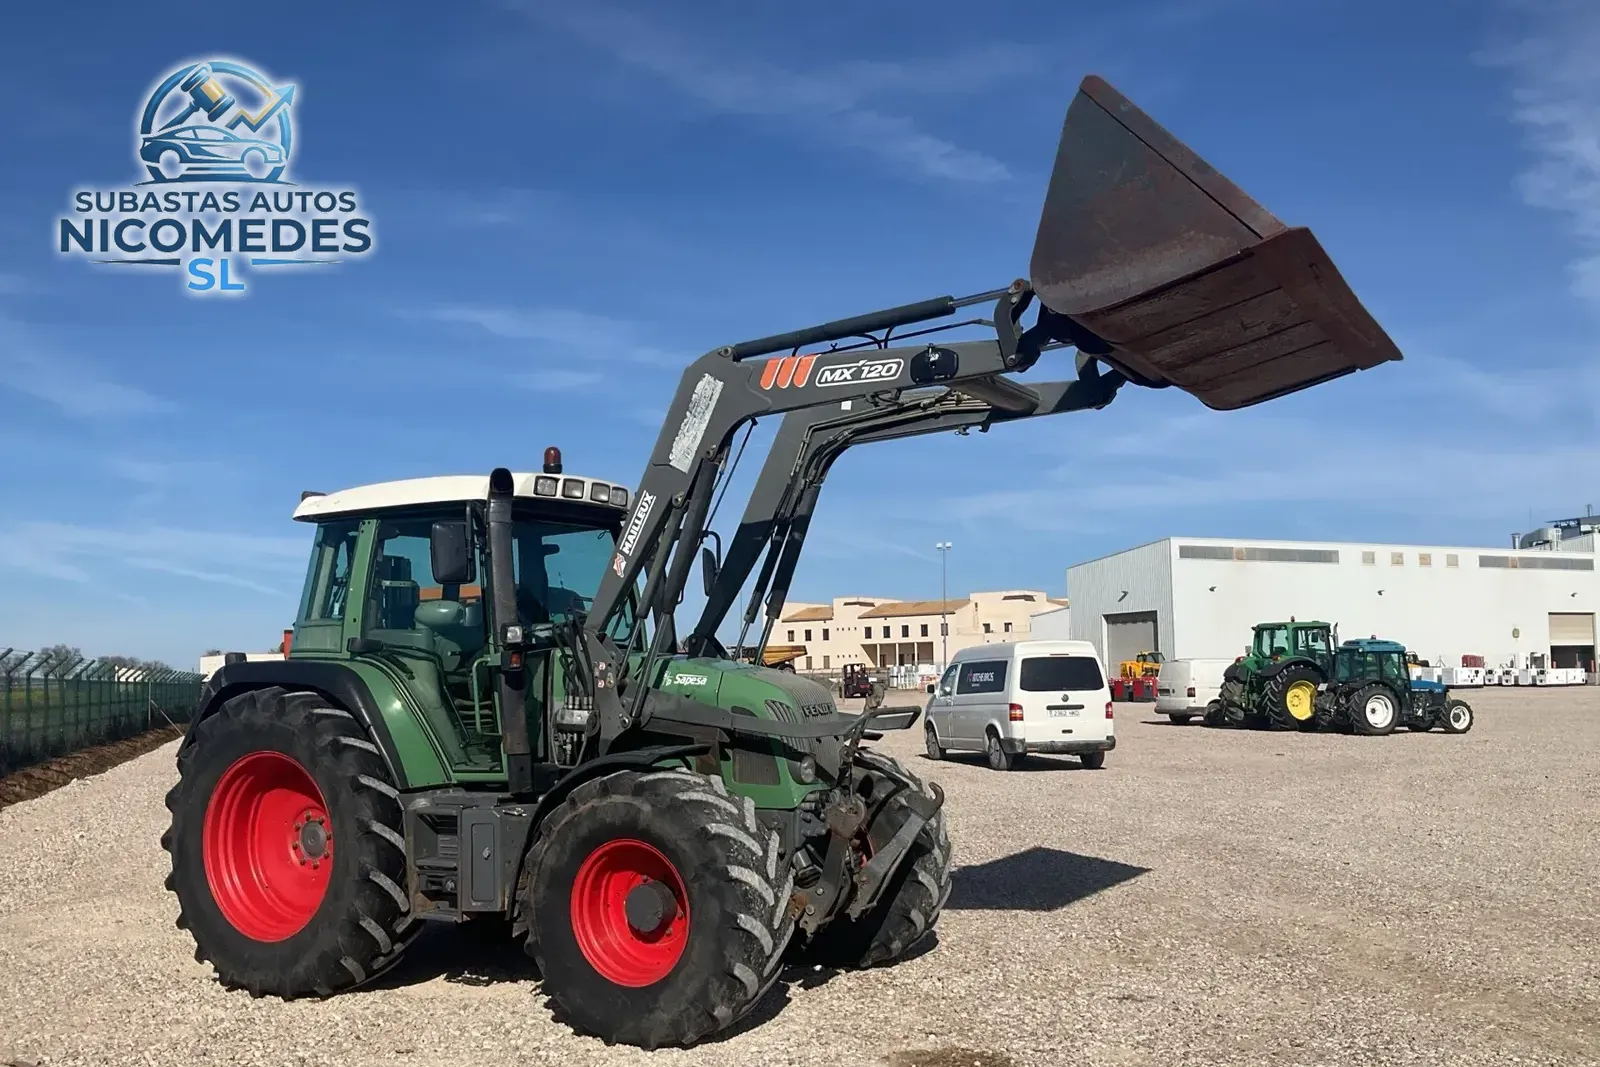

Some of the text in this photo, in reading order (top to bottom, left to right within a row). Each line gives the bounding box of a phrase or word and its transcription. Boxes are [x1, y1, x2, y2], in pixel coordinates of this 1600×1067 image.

[820, 363, 898, 383] MX 120
[622, 491, 654, 555] MAILLEUX
[673, 673, 709, 687] Sapesa
